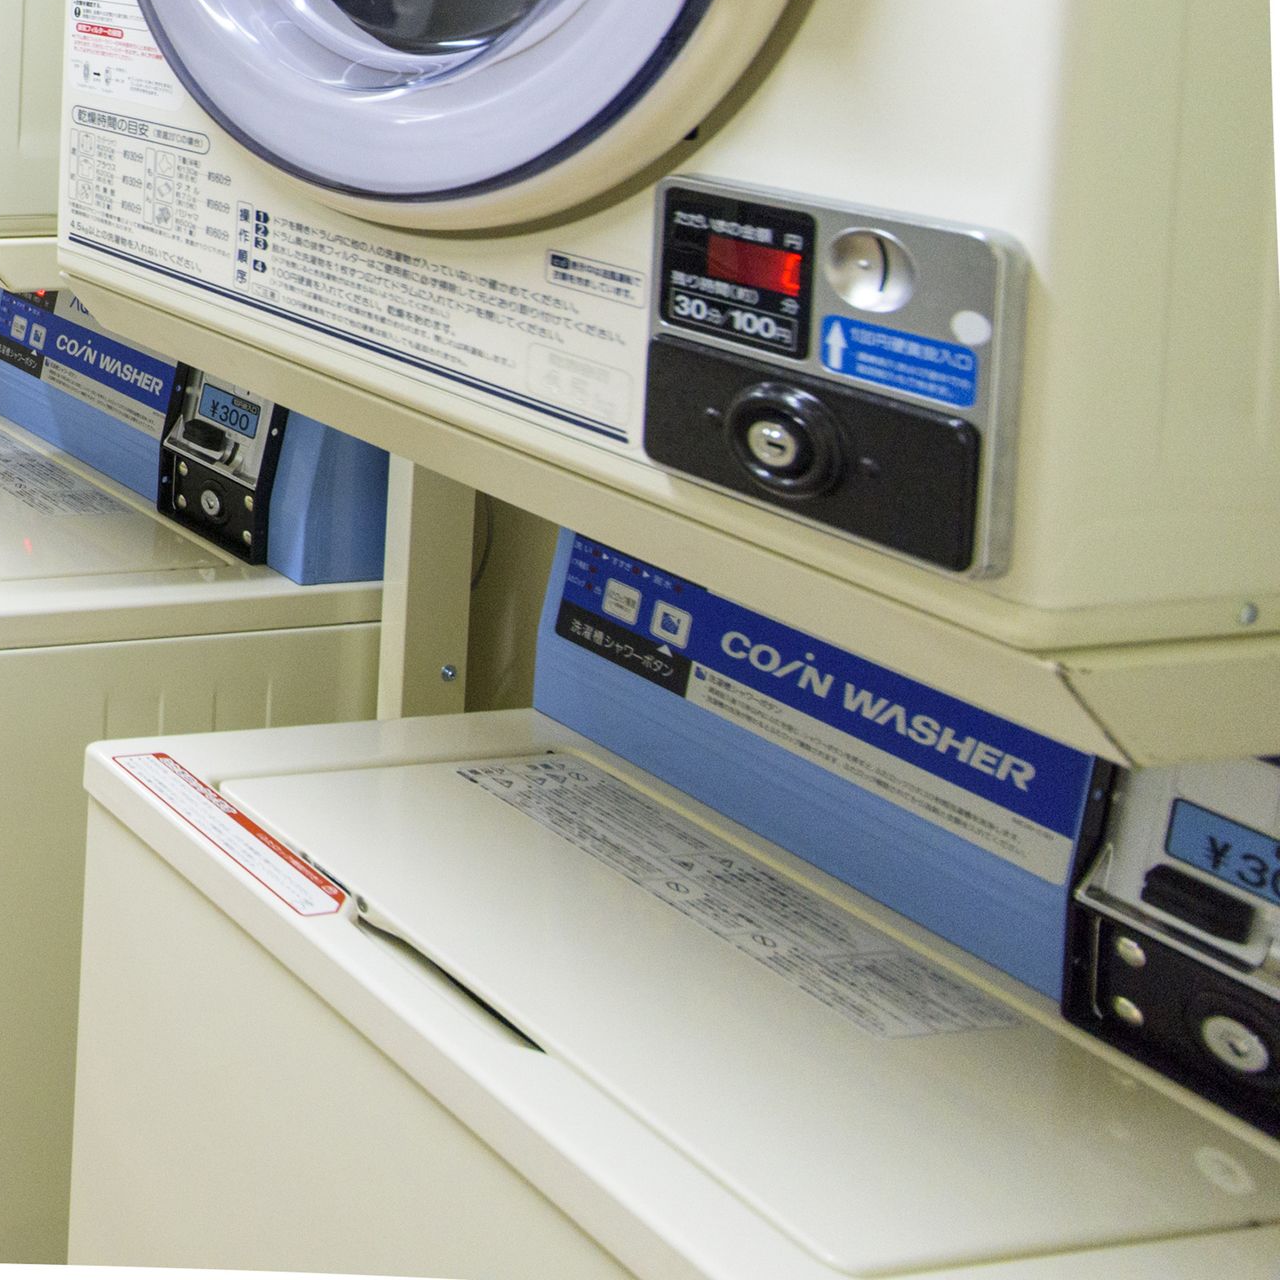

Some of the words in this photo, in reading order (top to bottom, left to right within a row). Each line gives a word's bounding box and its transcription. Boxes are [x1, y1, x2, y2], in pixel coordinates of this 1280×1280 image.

[78, 109, 149, 138] 乾燥時間の目安
[99, 356, 164, 397] WASHER
[211, 399, 250, 431] ¥300
[570, 618, 675, 677] 洗濯槽シャワーボタン
[843, 682, 1037, 793] WASHER
